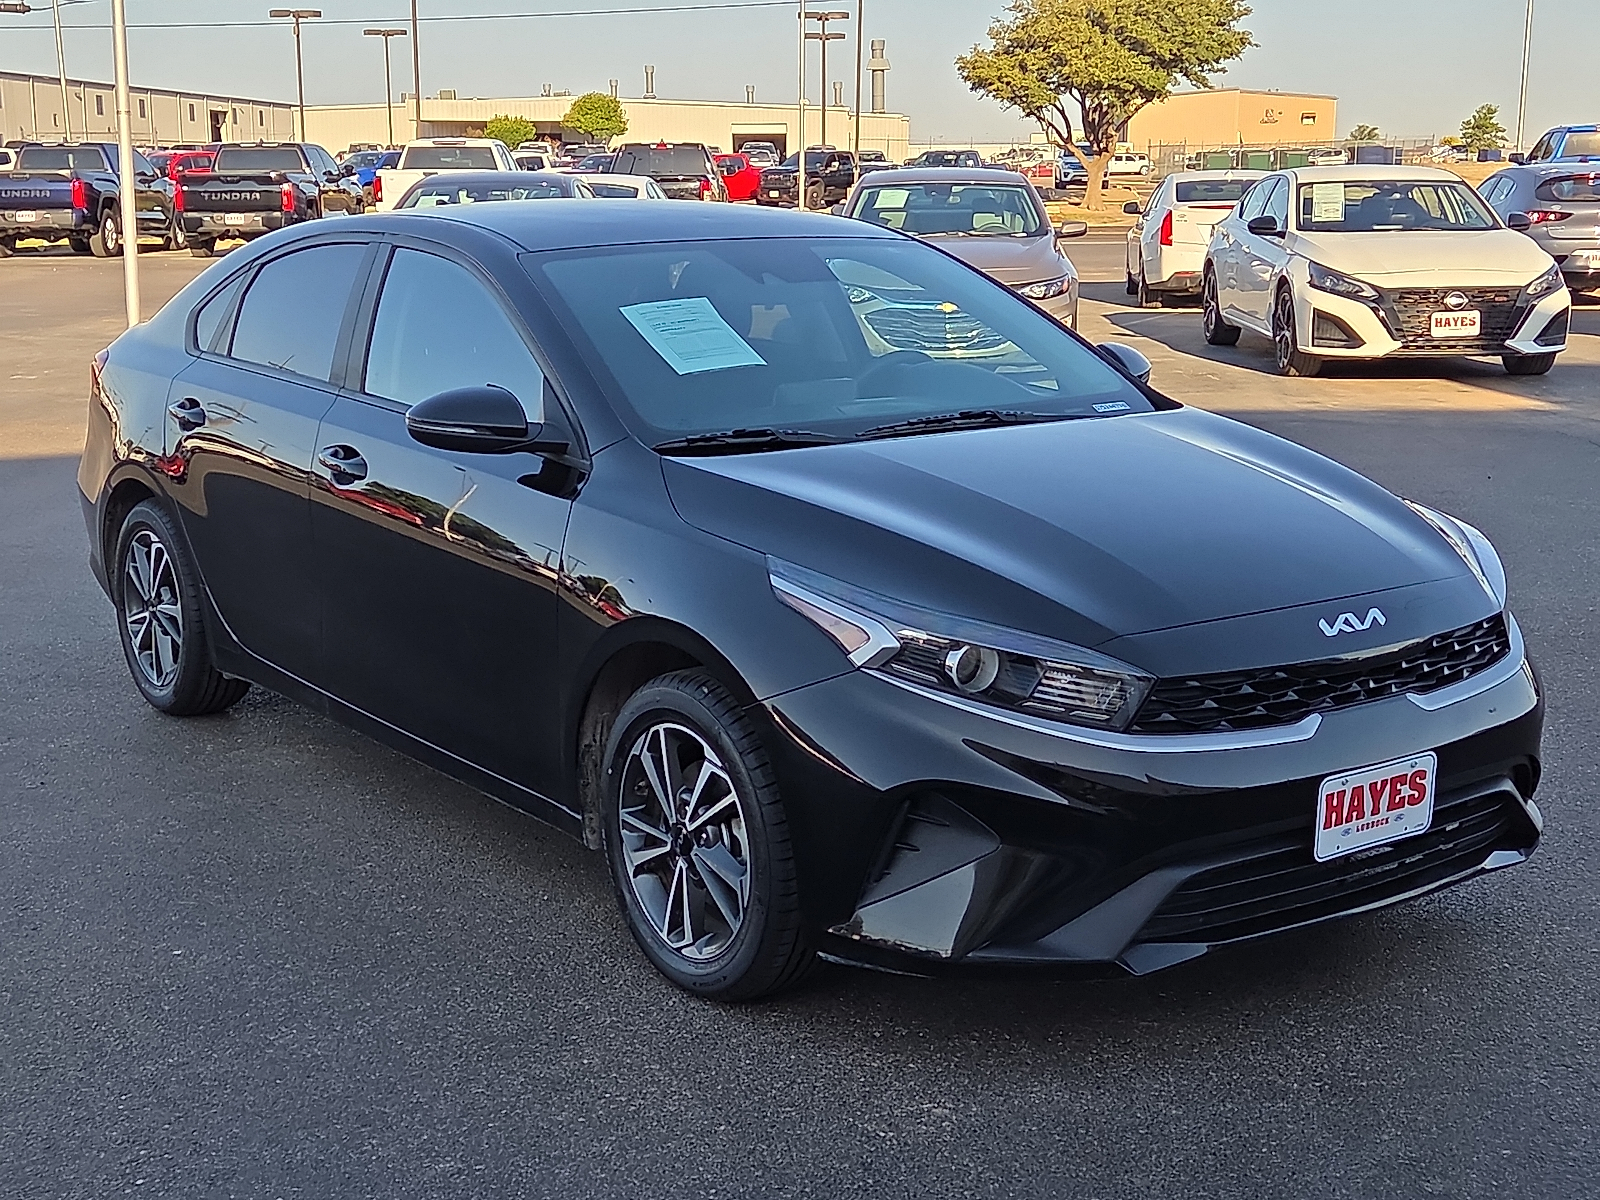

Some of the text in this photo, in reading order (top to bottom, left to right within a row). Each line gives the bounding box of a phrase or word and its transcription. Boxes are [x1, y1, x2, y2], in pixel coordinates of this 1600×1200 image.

[0, 190, 51, 198] UNDRA
[201, 192, 261, 201] TUNDRA
[1434, 316, 1477, 328] HAYES
[1318, 606, 1387, 637] KIA
[1322, 768, 1428, 831] HAYES
